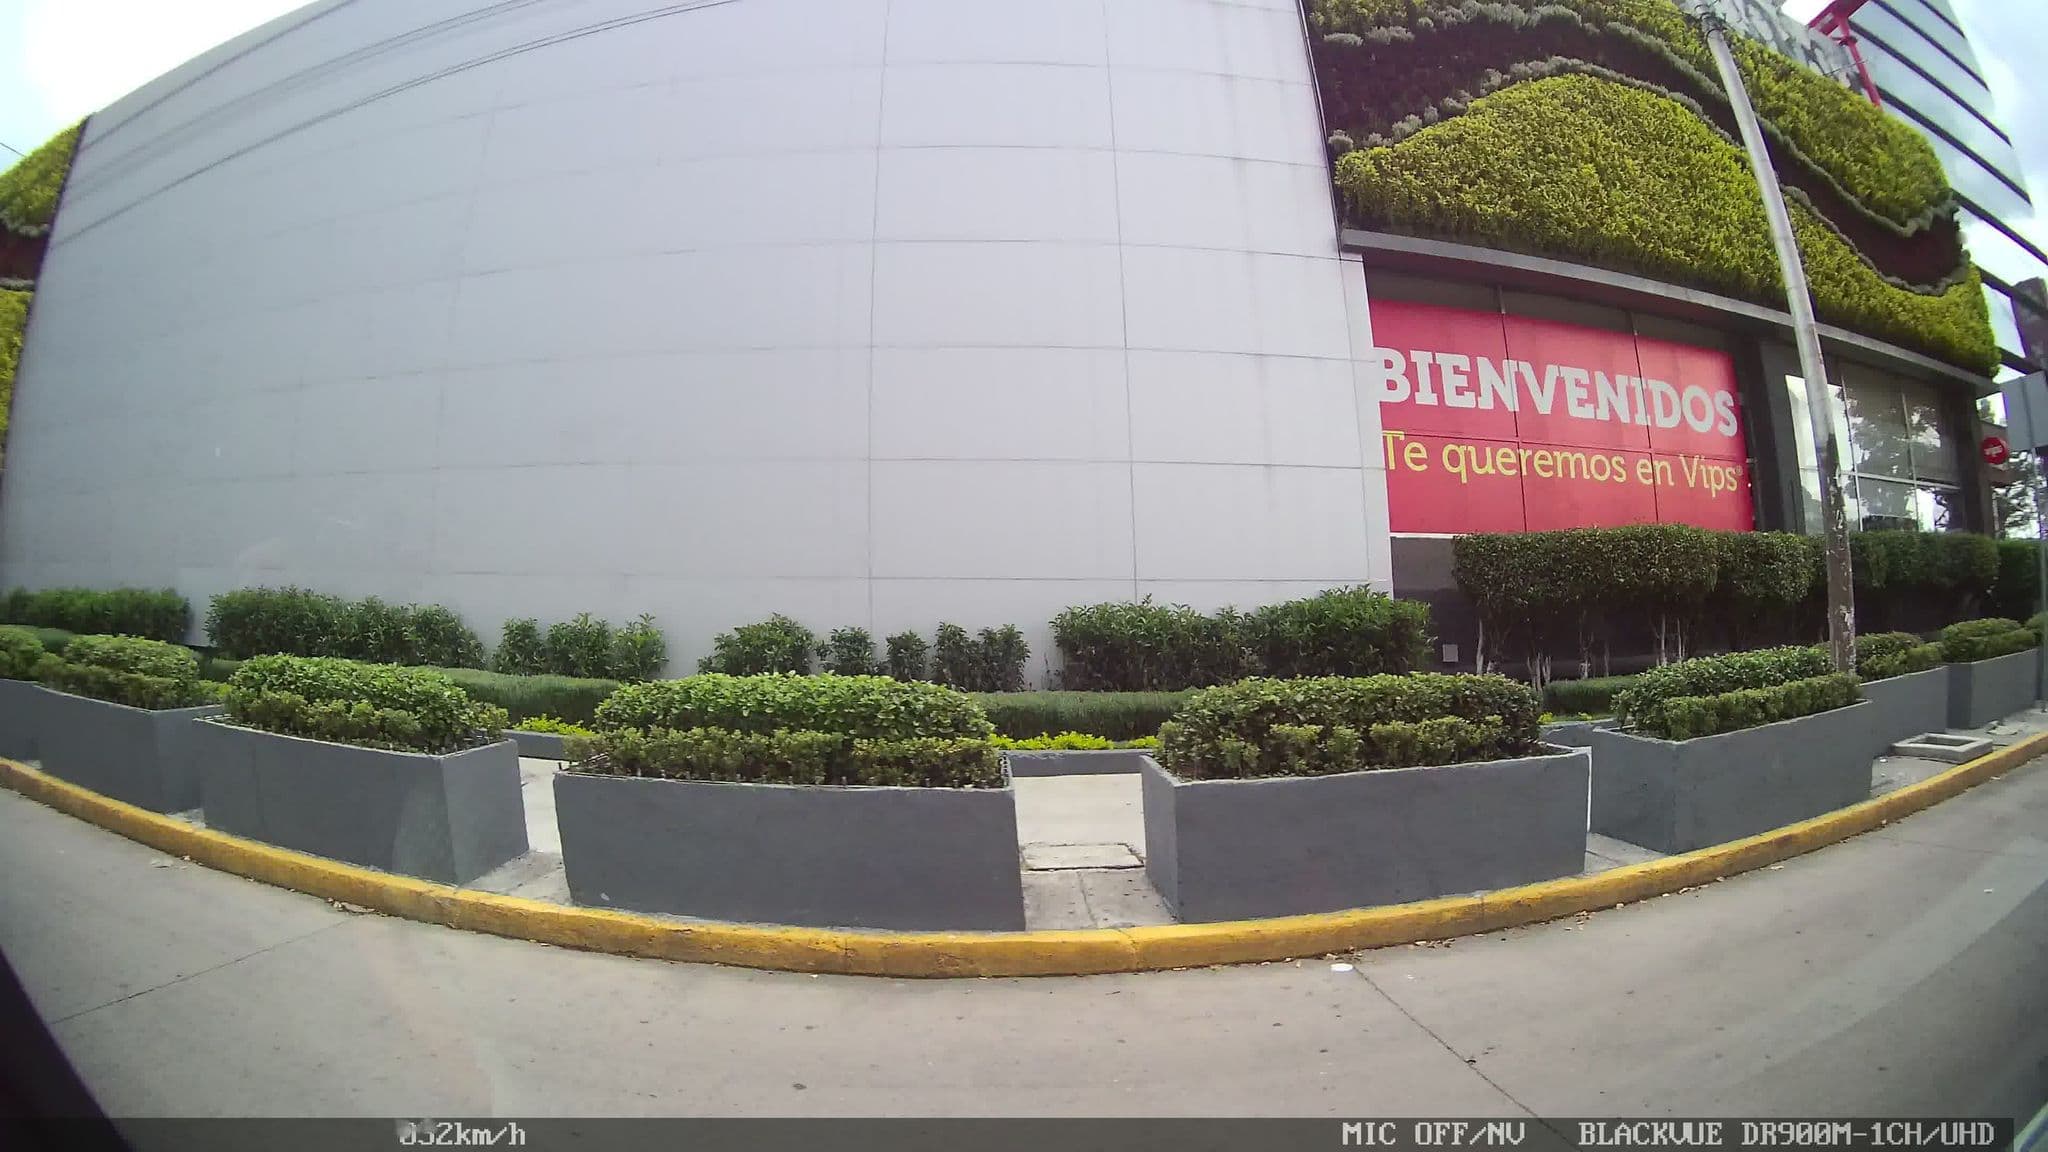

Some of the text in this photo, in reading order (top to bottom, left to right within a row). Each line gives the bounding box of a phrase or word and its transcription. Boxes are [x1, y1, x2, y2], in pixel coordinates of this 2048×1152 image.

[1375, 346, 1738, 437] BIENVENIDOS
[1382, 430, 1428, 472] Te
[1442, 443, 1627, 484] queremos
[1636, 458, 1675, 487] en
